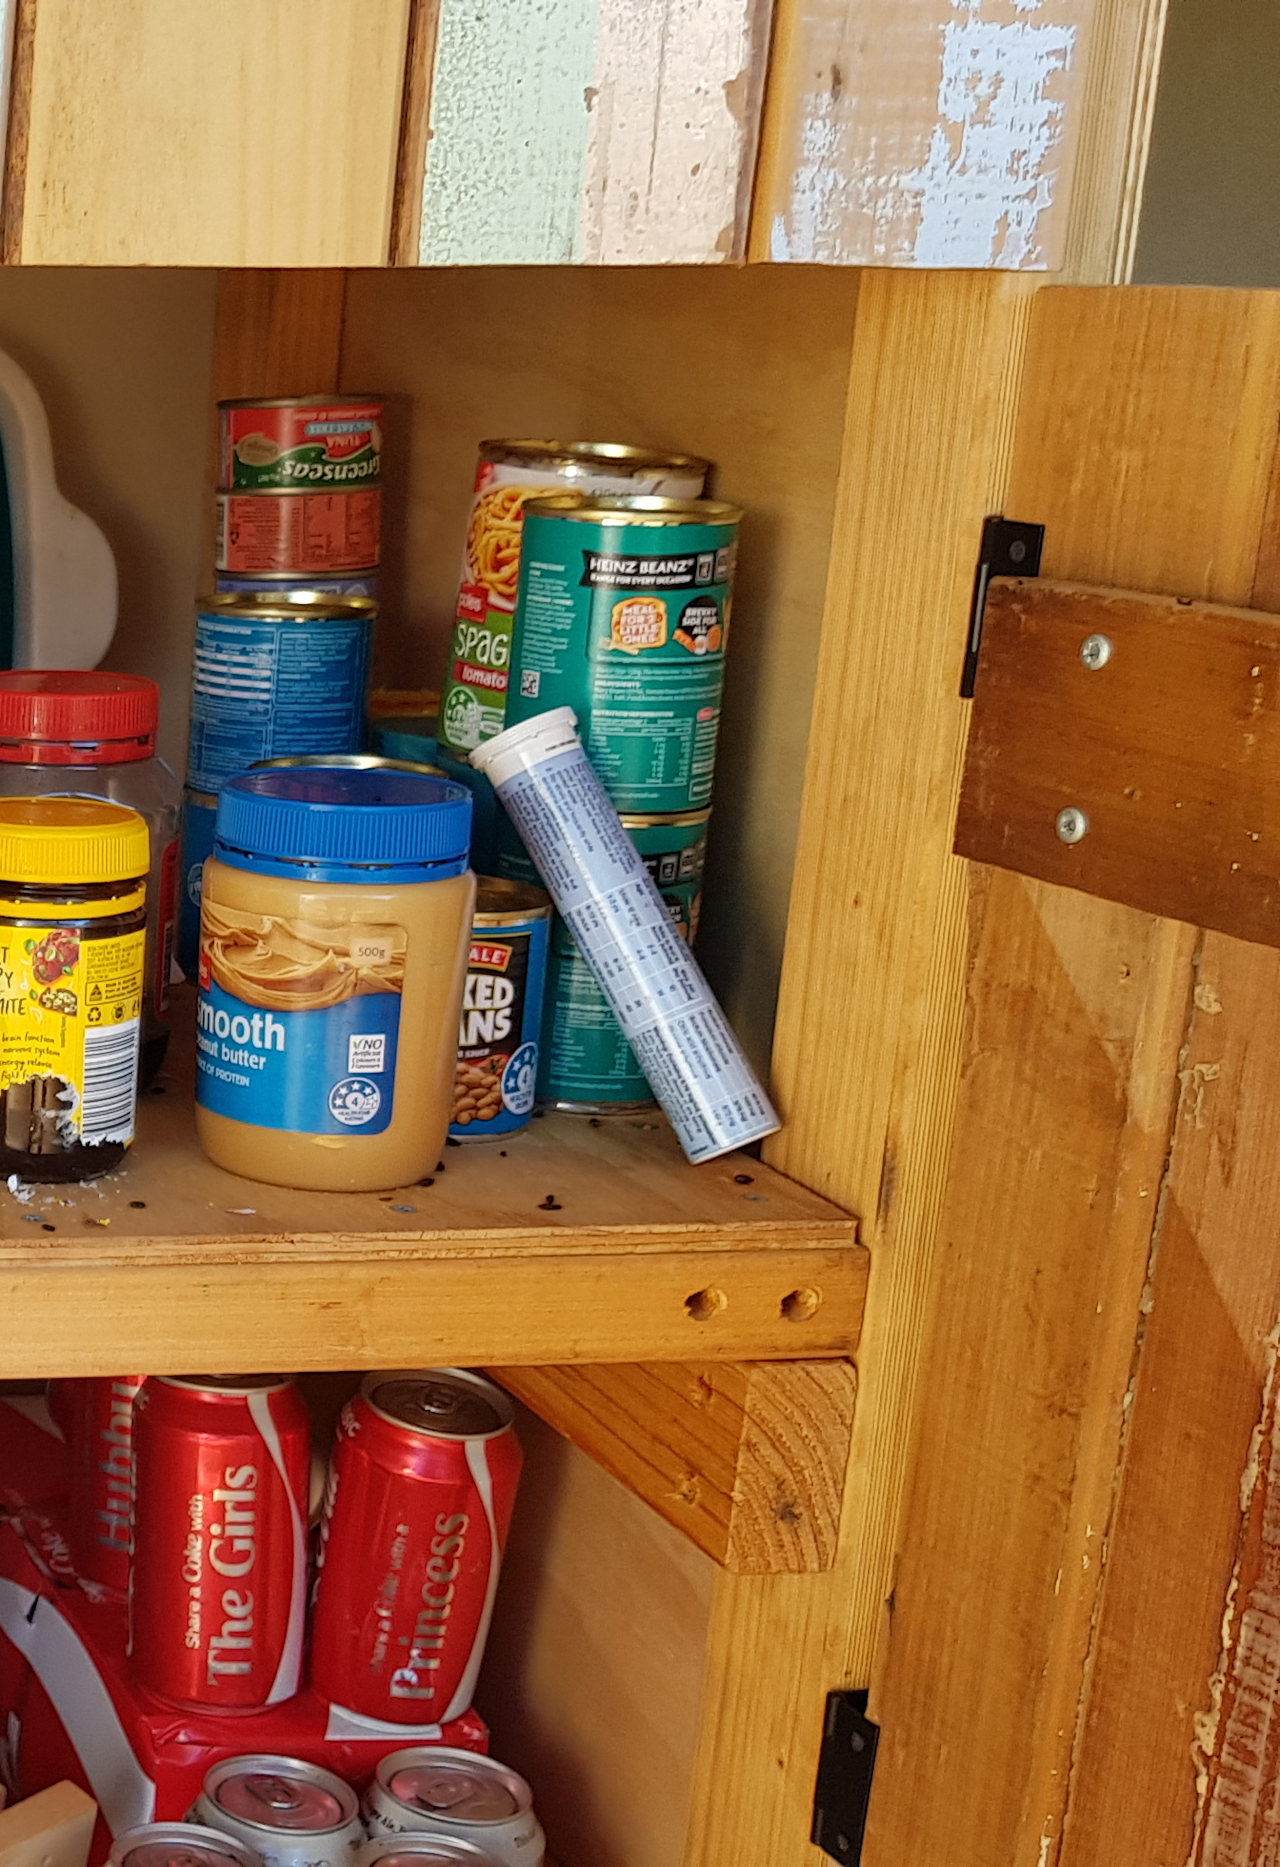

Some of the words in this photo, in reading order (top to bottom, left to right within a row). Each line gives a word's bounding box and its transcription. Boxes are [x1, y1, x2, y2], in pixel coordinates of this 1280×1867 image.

[326, 435, 362, 448] TUNA
[281, 455, 381, 480] Greenseas
[590, 556, 637, 574] HEINZ
[640, 557, 692, 574] BEANZ
[461, 664, 508, 690] tomato
[357, 946, 386, 959] 500g
[469, 946, 505, 965] ALE
[463, 973, 515, 1010] KED
[1, 1033, 22, 1042] brain
[24, 1032, 56, 1044] function
[458, 1007, 513, 1047] ANS
[221, 1043, 267, 1070] butter
[362, 1039, 383, 1050] NO
[27, 1056, 53, 1068] release
[206, 1063, 215, 1077] OF
[215, 1067, 251, 1087] PROTEIN
[350, 1096, 359, 1107] 4
[188, 1493, 204, 1531] with
[209, 1464, 259, 1578] Girls
[182, 1533, 203, 1584] Coke
[190, 1586, 202, 1599] a
[390, 1511, 471, 1700] Princess
[184, 1601, 202, 1649] Share
[207, 1589, 255, 1686] The
